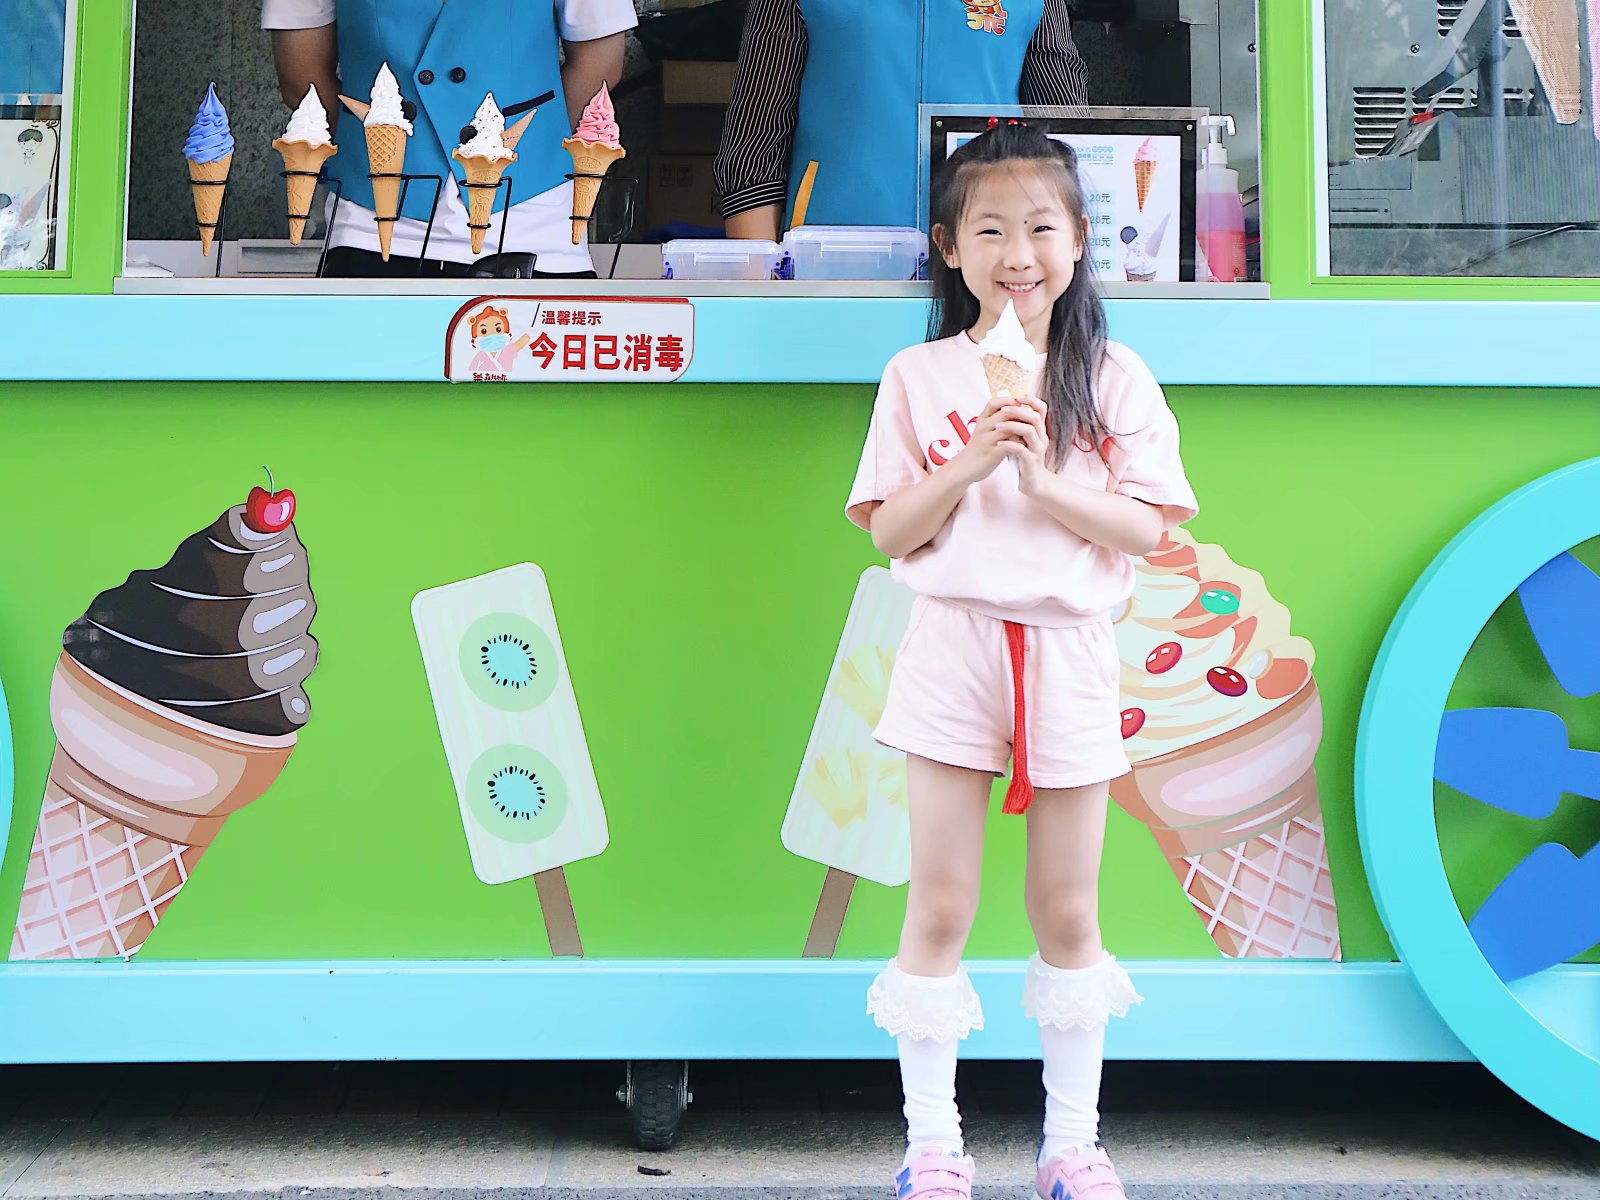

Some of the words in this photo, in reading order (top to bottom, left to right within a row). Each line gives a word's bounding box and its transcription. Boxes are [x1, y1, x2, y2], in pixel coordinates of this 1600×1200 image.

[1089, 193, 1111, 203] 20元
[1090, 215, 1111, 225] 20元
[541, 310, 602, 326] 温馨提示
[528, 331, 684, 372] 今日已消毒
